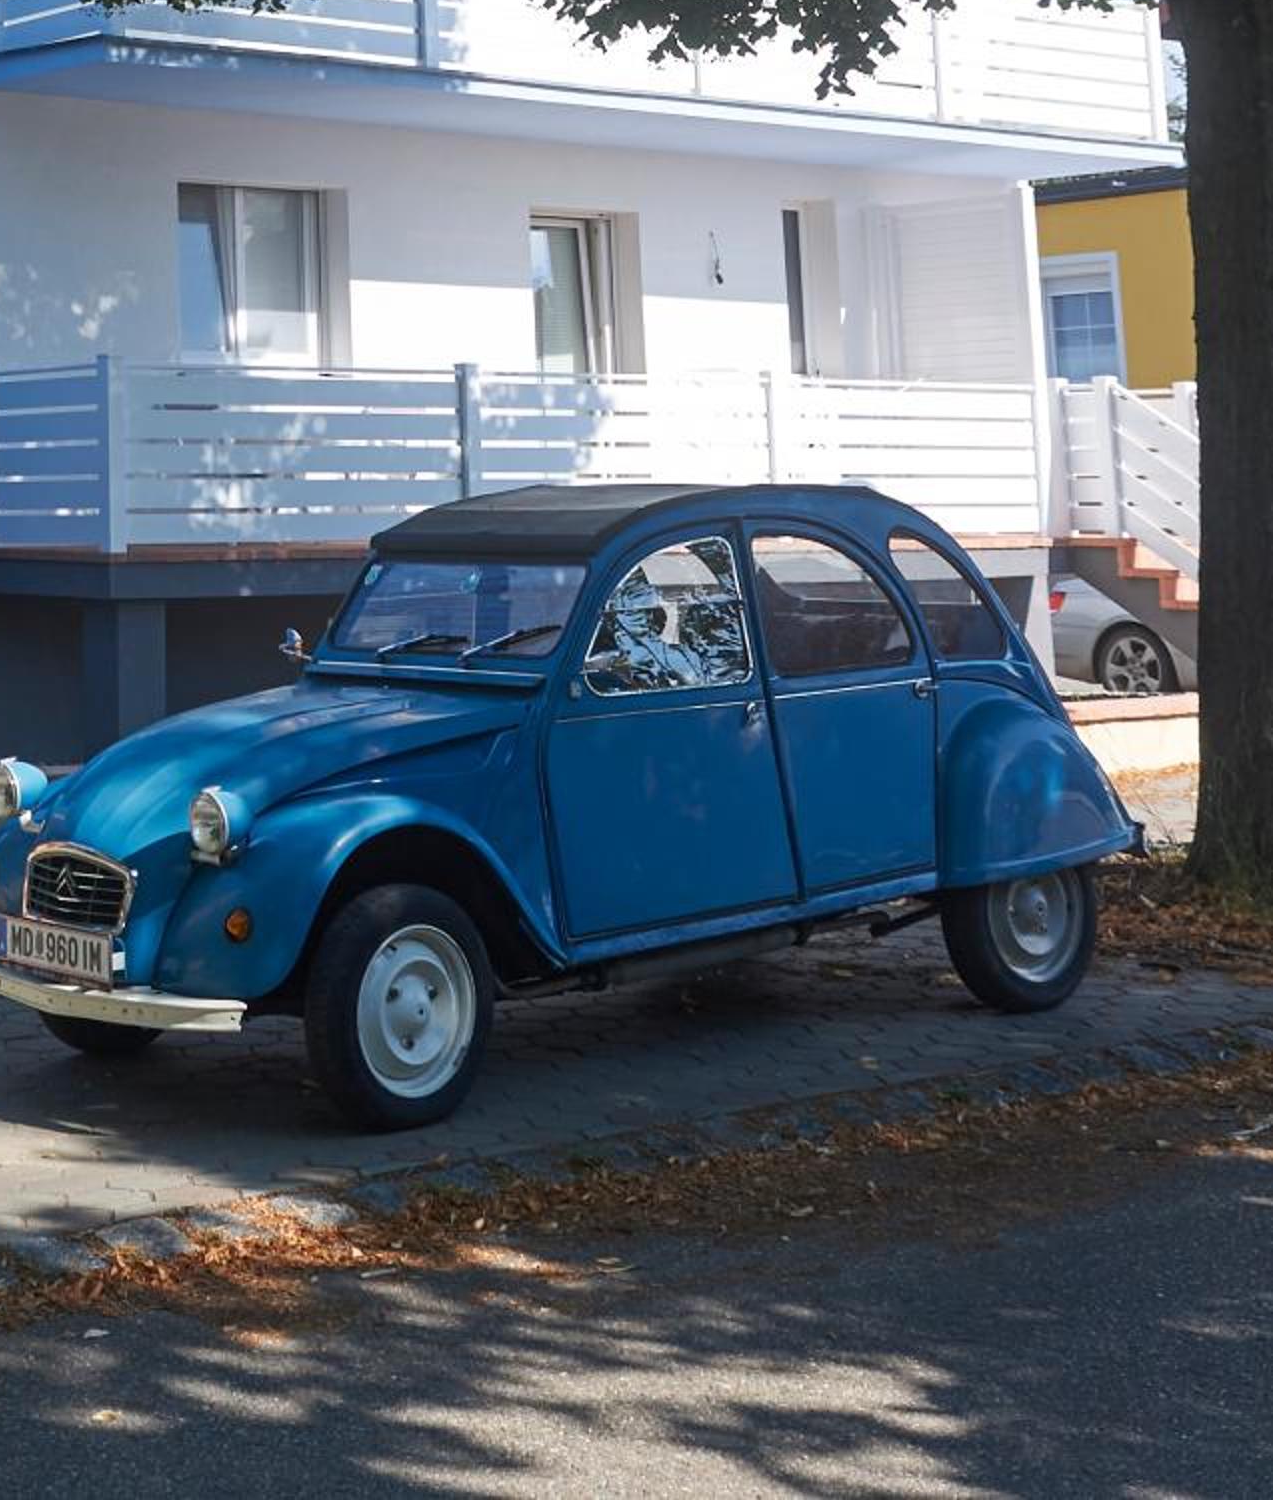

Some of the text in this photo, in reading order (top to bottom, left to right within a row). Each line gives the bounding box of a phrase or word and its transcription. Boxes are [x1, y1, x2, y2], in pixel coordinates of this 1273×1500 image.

[11, 925, 102, 973] MD 960 IM
